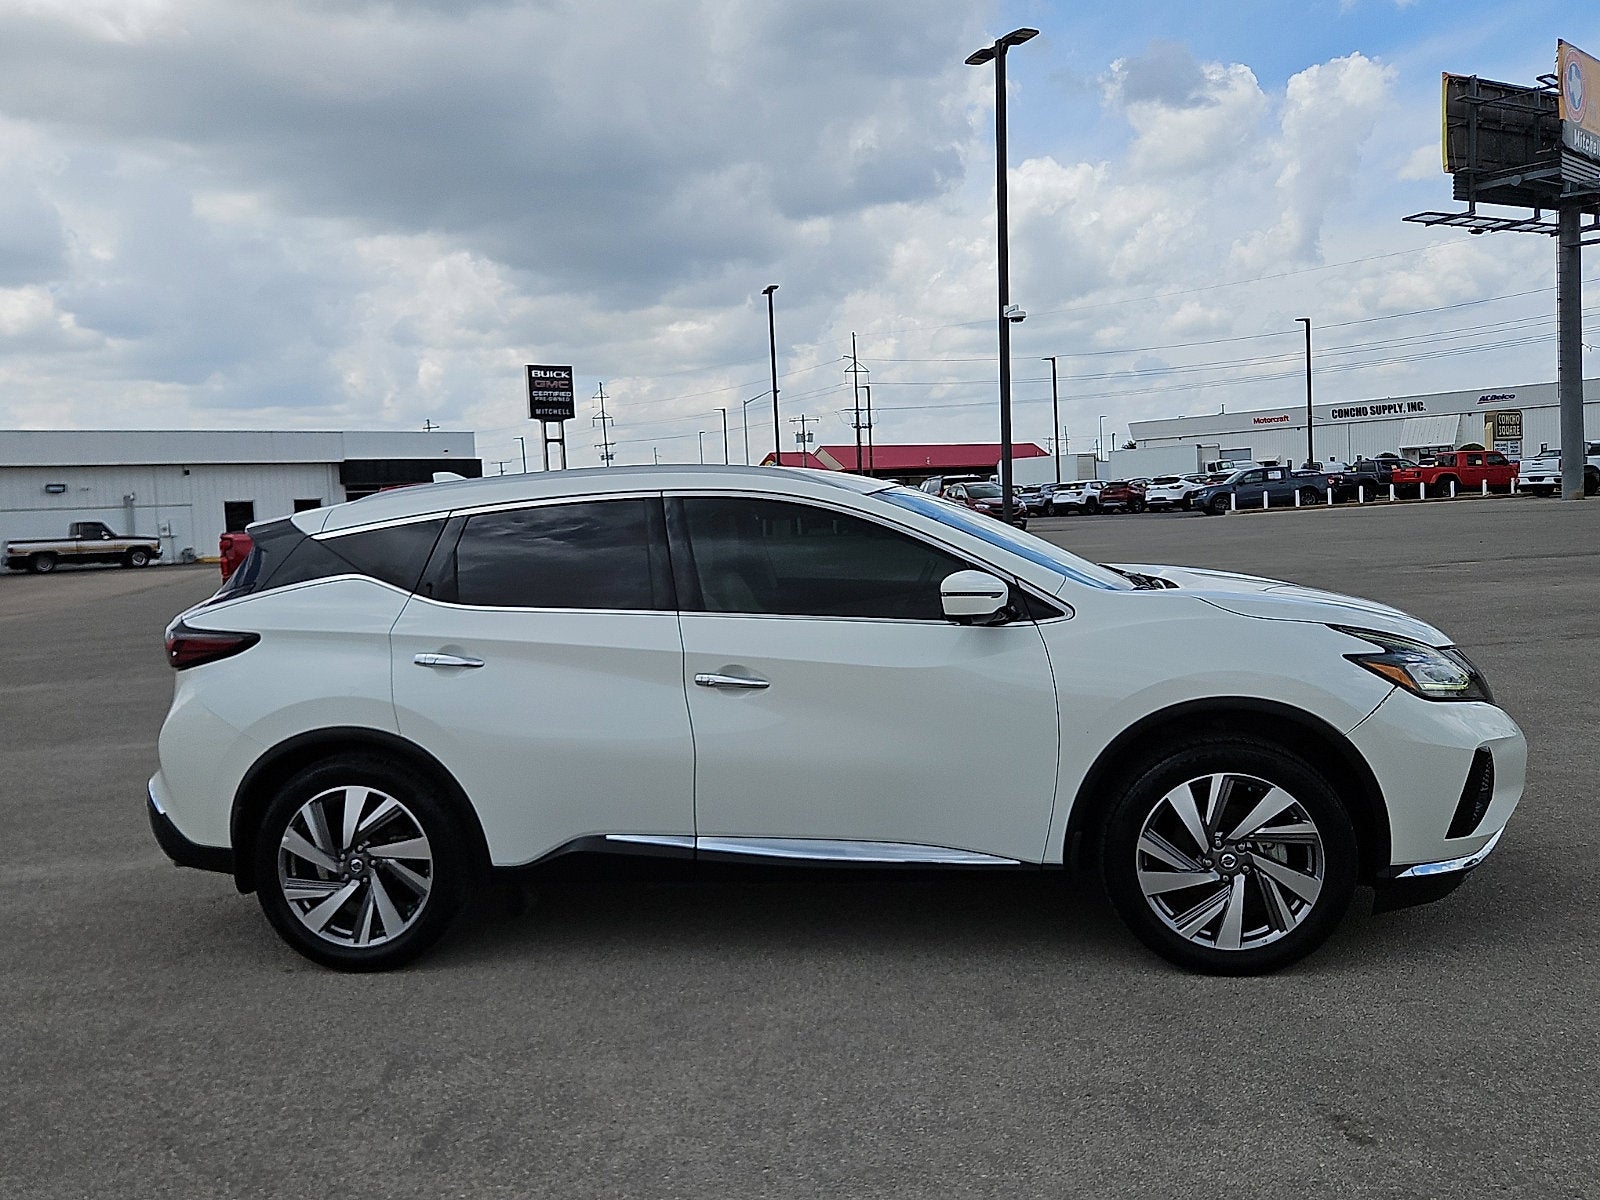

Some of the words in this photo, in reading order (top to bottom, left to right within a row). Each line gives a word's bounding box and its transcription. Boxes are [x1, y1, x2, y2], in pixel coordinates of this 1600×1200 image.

[531, 370, 570, 378] BUICK
[534, 380, 569, 388] GMC
[1331, 406, 1368, 419] CONCHO
[1369, 402, 1406, 415] SUPPLY,
[1406, 401, 1427, 412] INC.
[1253, 415, 1289, 424] Motorcraft
[1498, 414, 1520, 424] CONCHO
[1498, 425, 1520, 435] SQUARE
